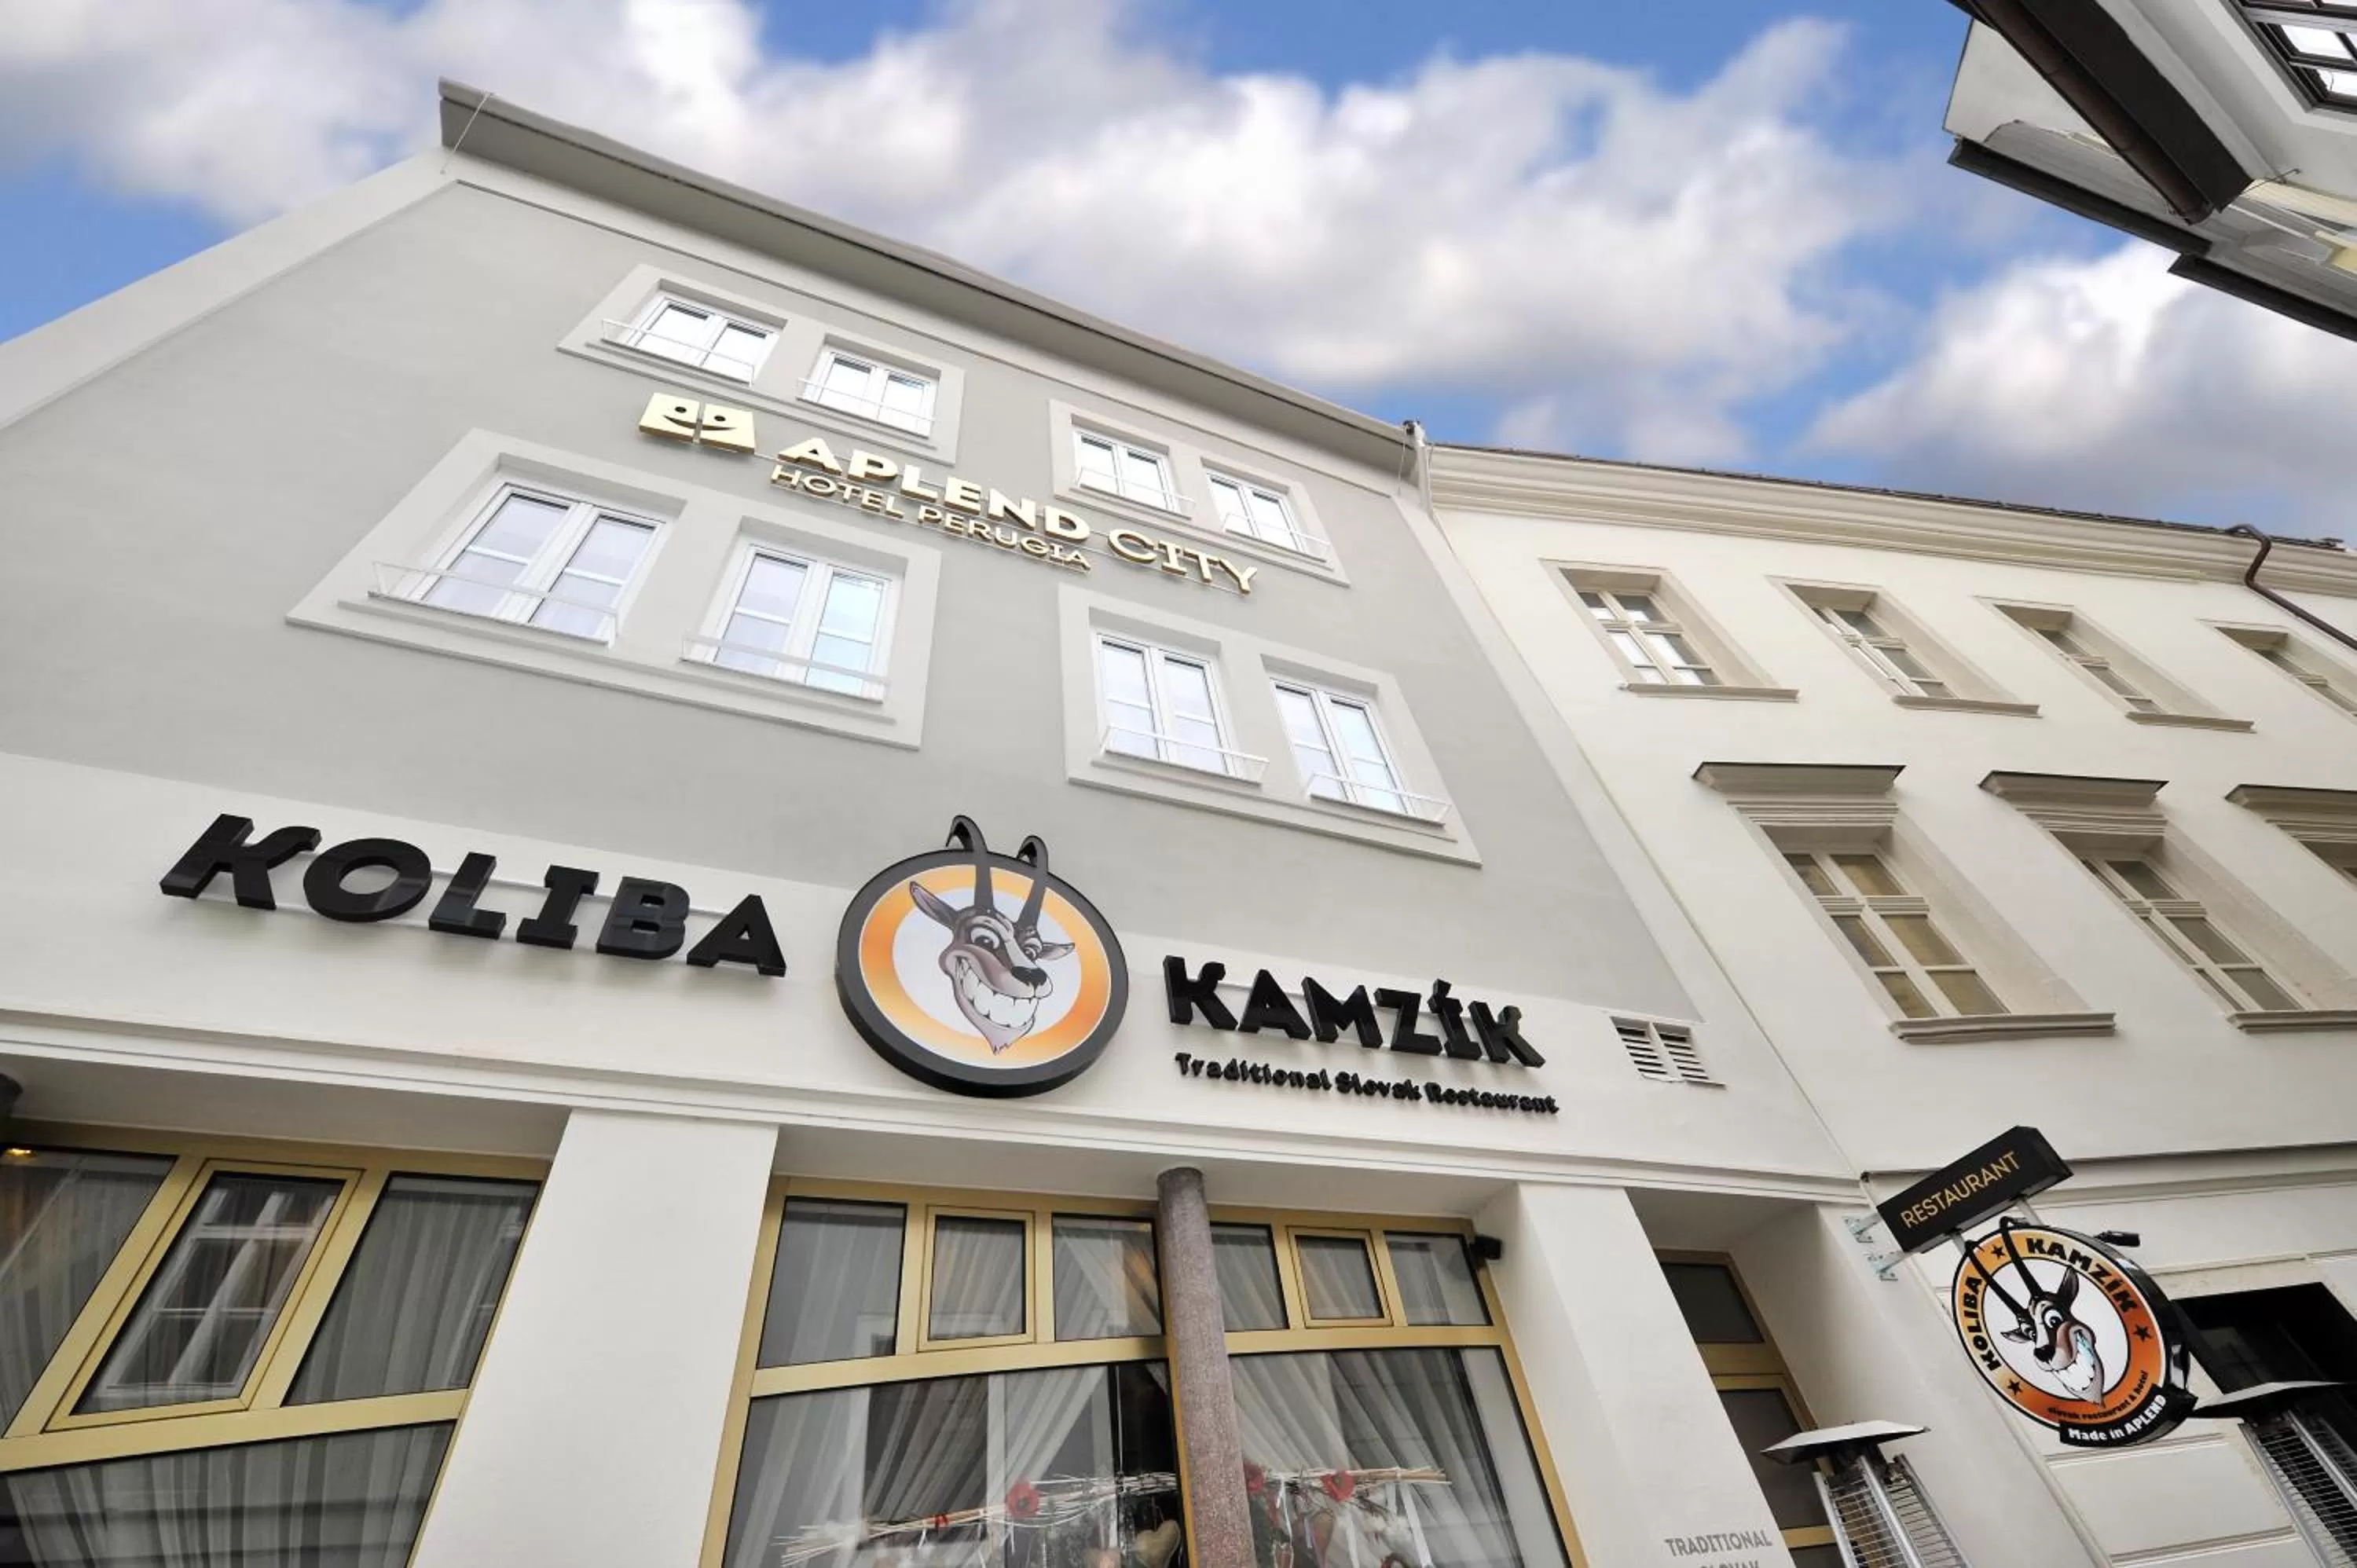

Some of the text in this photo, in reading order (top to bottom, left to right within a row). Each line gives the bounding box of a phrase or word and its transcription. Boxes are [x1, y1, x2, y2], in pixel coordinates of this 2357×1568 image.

[771, 463, 1091, 573] HOTEL PERUGIA
[777, 437, 1259, 595] APLEND CITY
[160, 813, 786, 977] KOLIBA
[1162, 954, 1546, 1068] KAMZÍK
[1175, 1052, 1560, 1114] Traditional Slovak Restaurant
[1899, 1151, 2022, 1229] RESTAURANT
[1964, 1277, 2001, 1372] KOLIBA
[2068, 1394, 2167, 1441] Made in APLEND
[1663, 1530, 1773, 1556] TRADITIONAL
